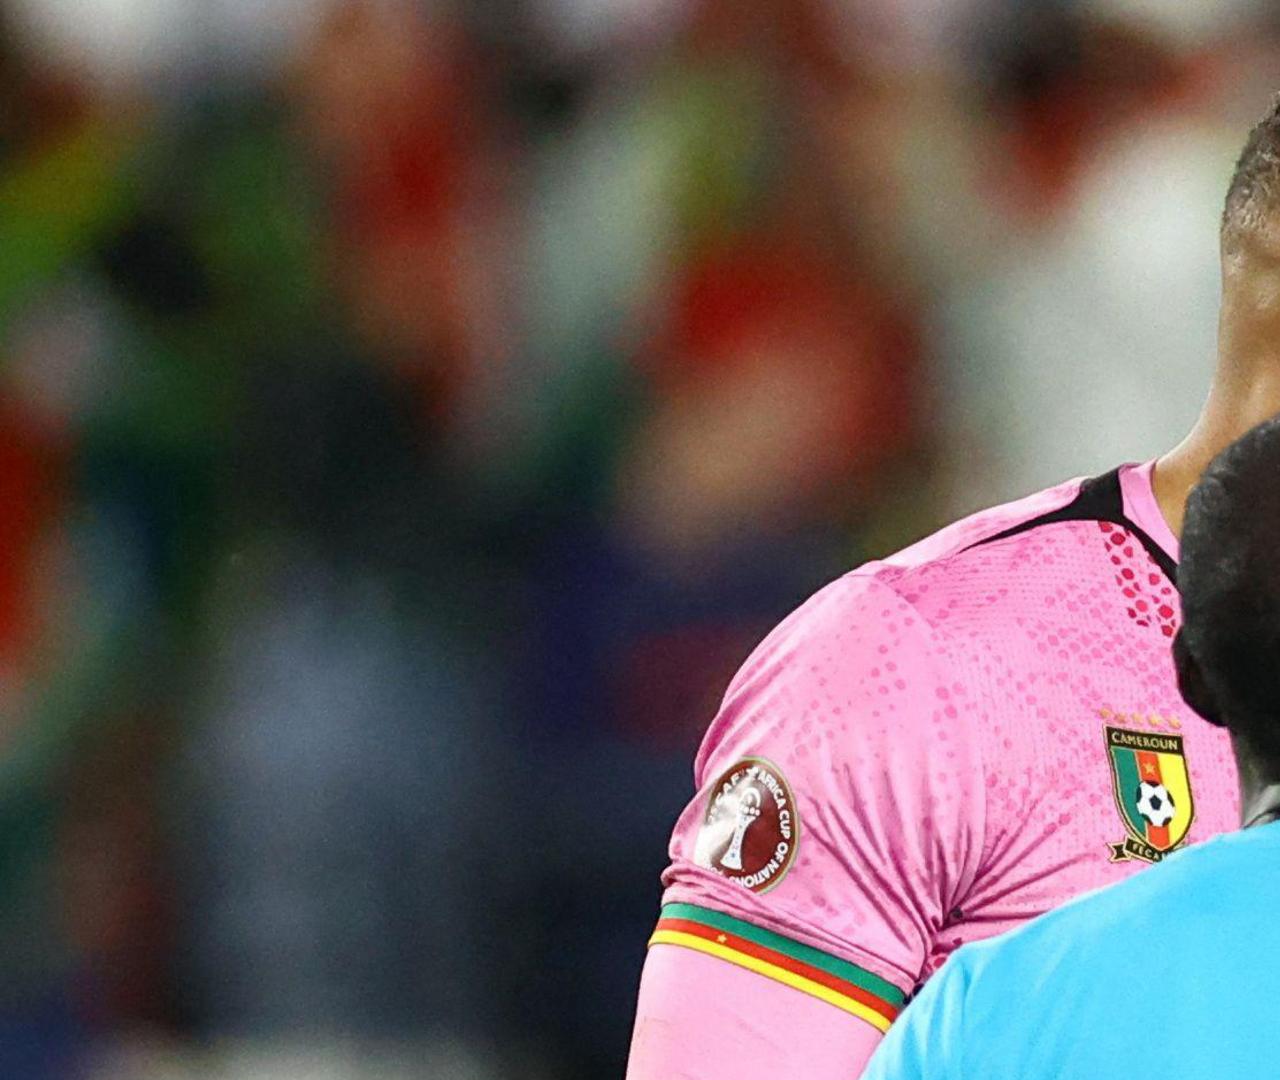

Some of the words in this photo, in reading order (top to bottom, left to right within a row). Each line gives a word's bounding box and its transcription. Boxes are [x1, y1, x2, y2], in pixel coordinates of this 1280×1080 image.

[1111, 731, 1178, 750] CAMEROUN
[758, 771, 787, 810] AFRICA
[779, 810, 791, 839] CUP
[775, 842, 788, 862] OF
